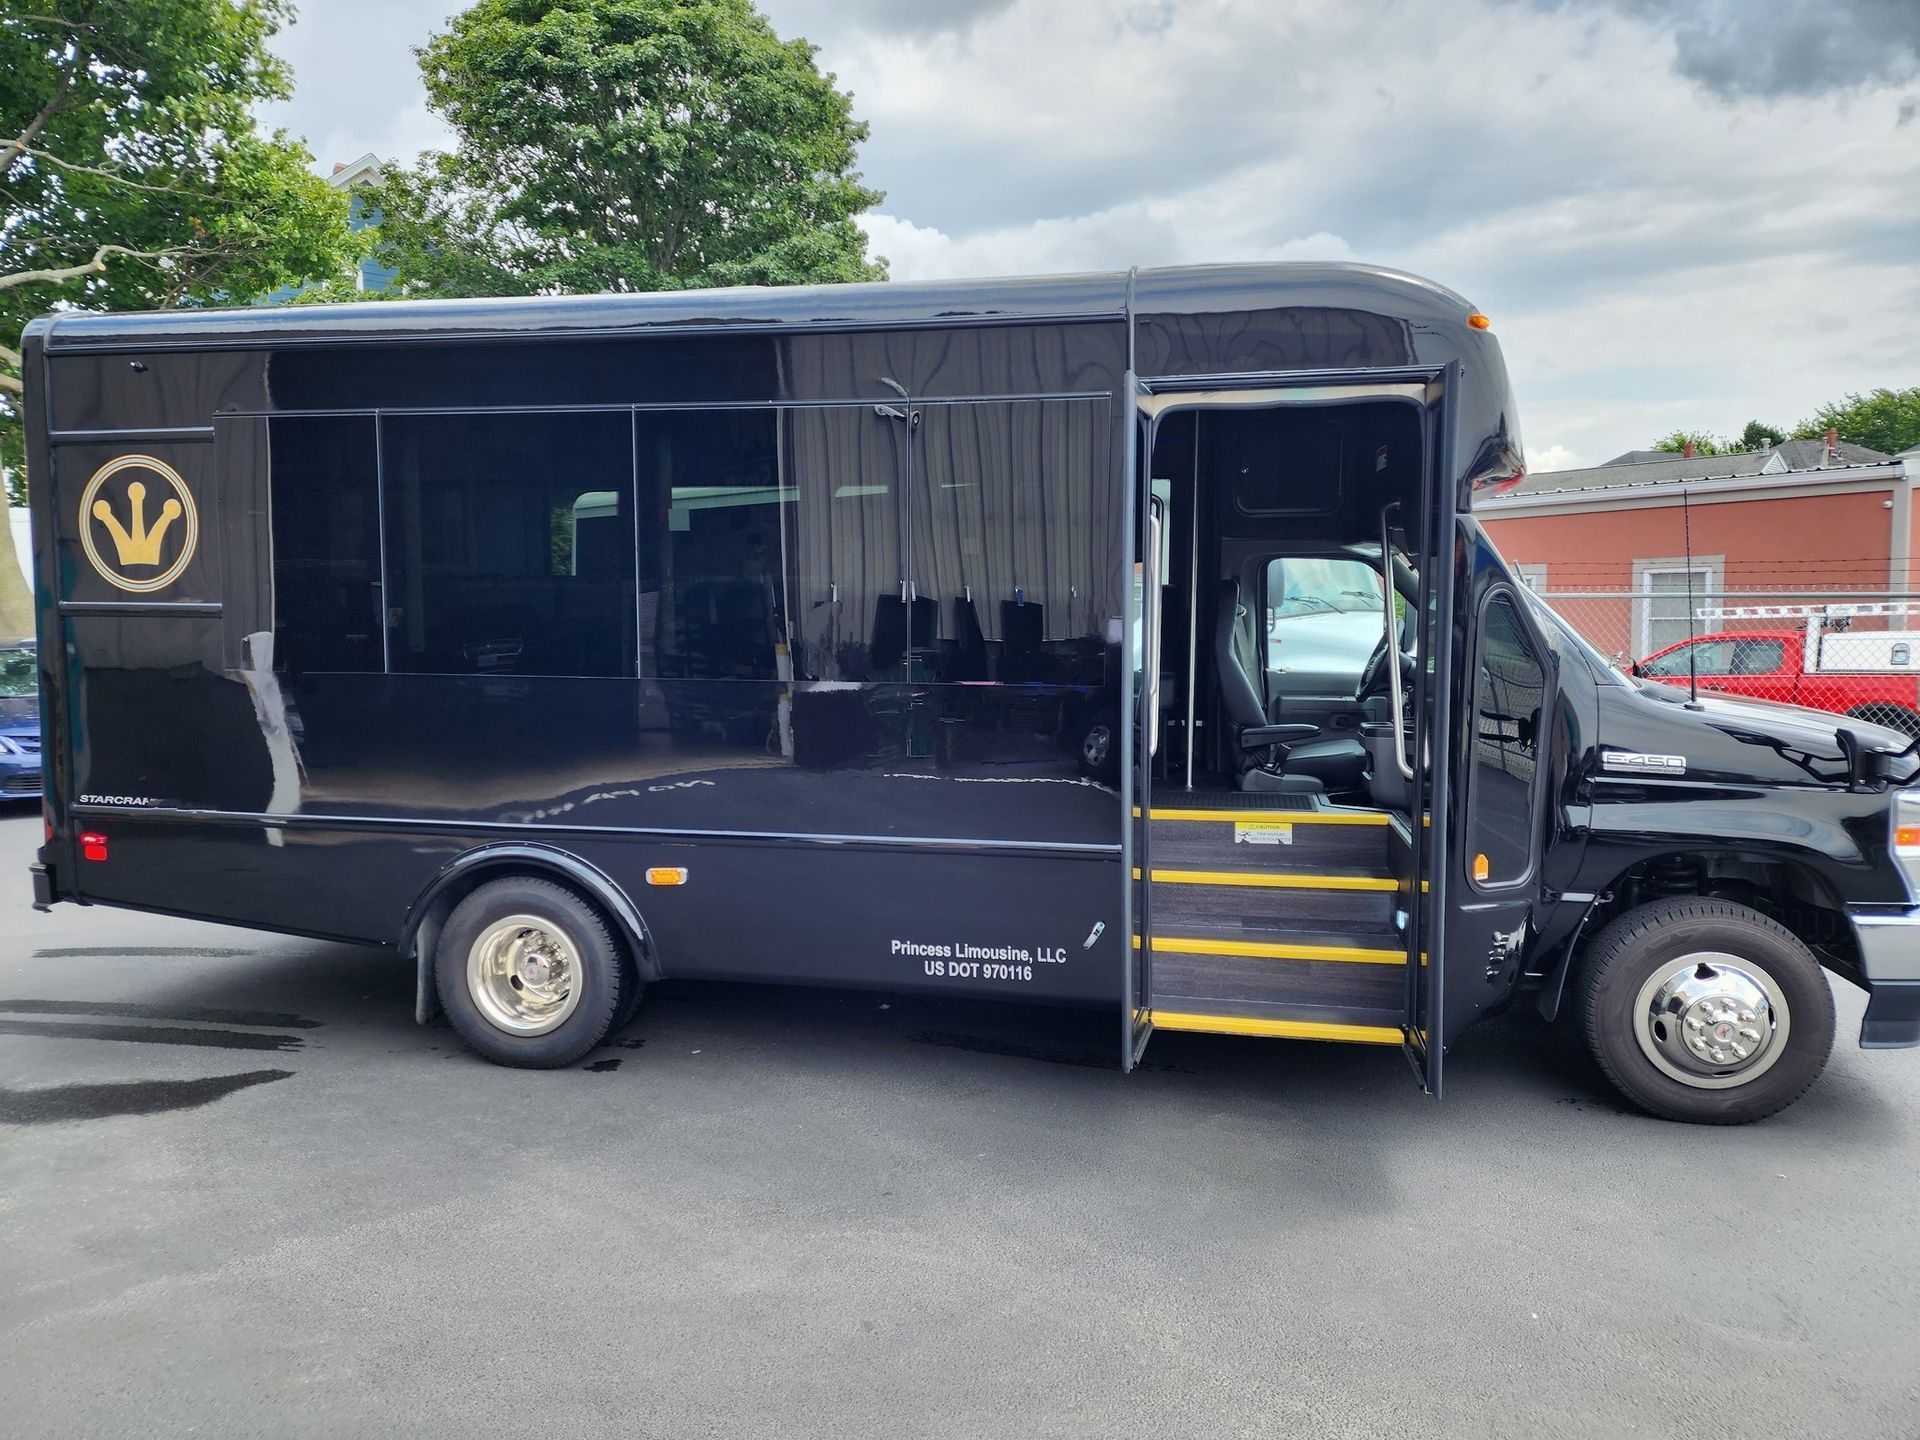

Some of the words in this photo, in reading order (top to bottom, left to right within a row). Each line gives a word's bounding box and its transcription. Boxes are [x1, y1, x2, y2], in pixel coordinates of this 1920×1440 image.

[891, 940, 951, 957] Princess
[955, 943, 1033, 964] Limousine,
[1037, 947, 1067, 964] LLC
[925, 960, 945, 977] US
[949, 961, 979, 978] DOT
[983, 964, 1032, 981] 970116
